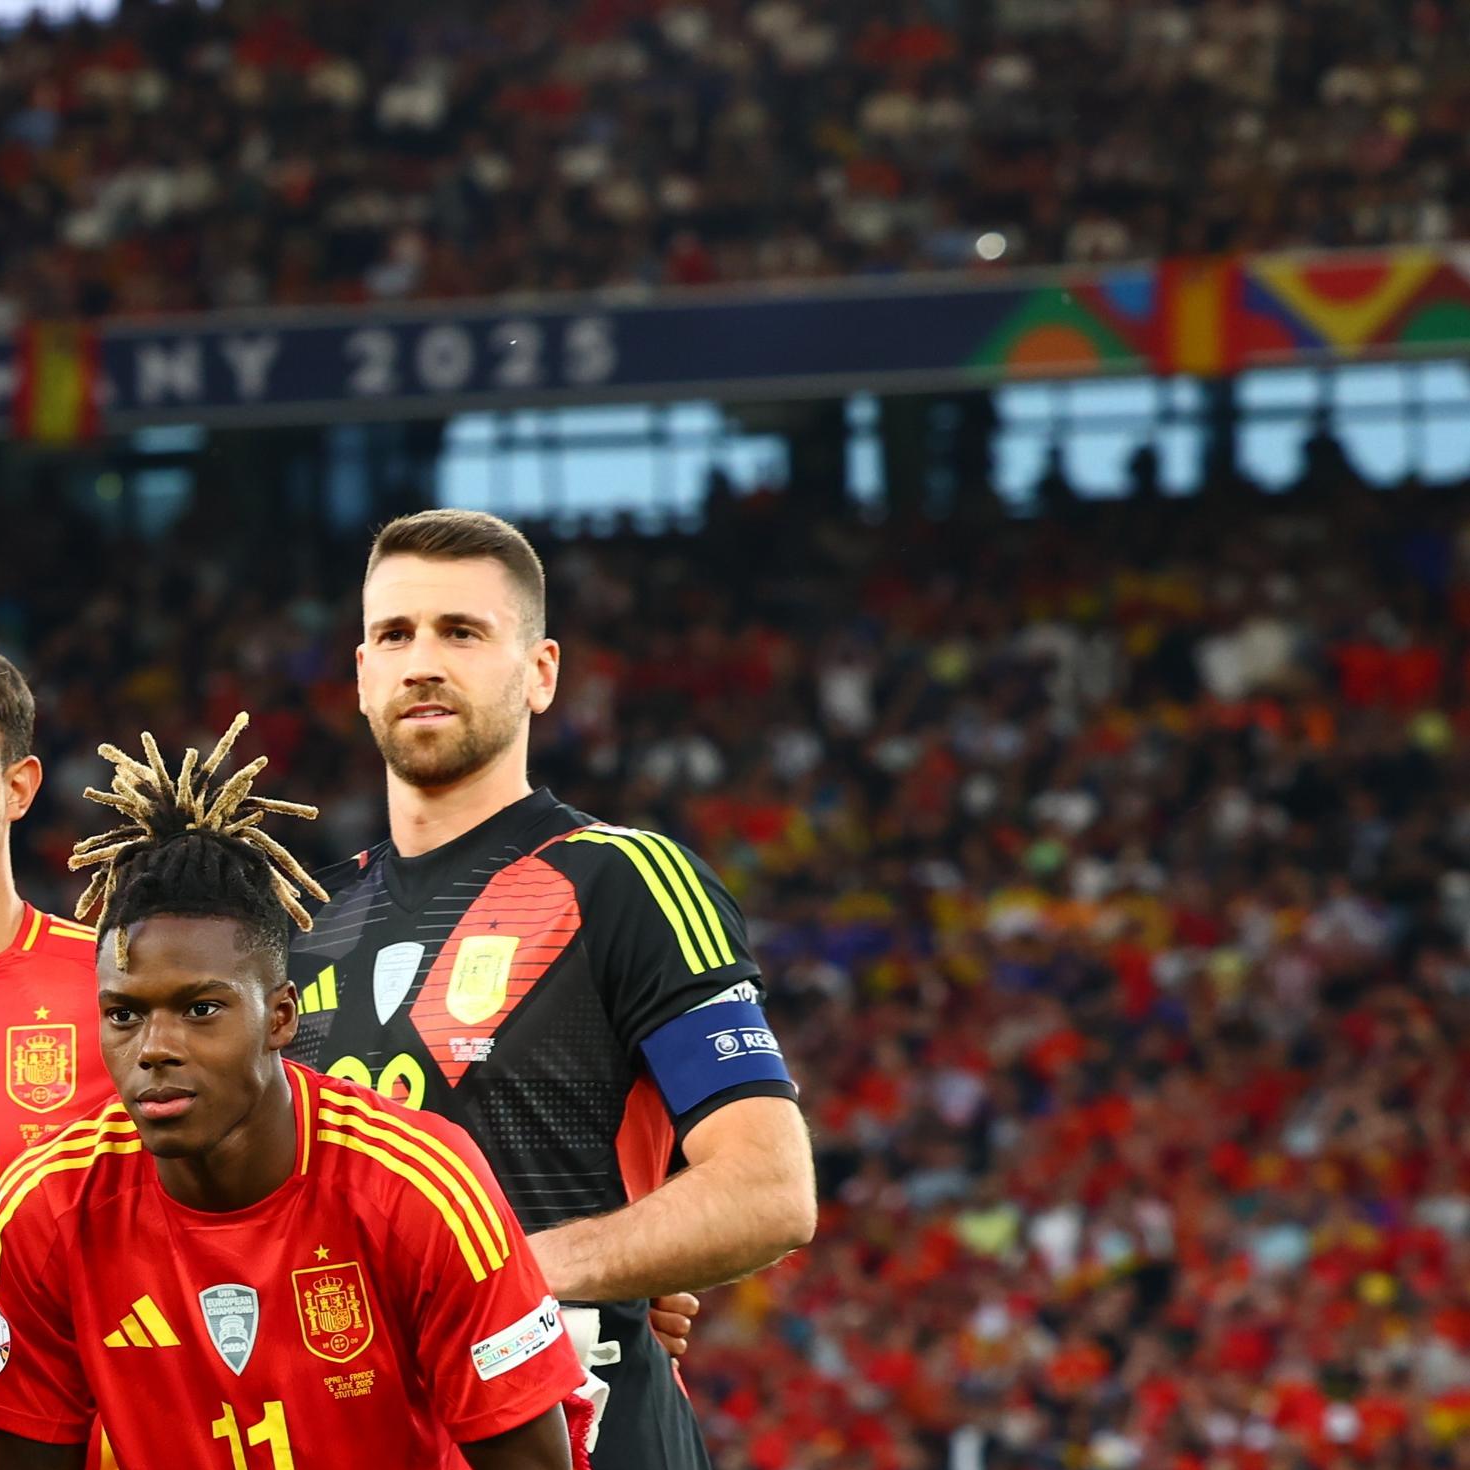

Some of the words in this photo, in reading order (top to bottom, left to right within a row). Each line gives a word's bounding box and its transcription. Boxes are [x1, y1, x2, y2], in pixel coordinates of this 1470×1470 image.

[345, 318, 615, 397] 2025
[205, 1295, 252, 1308] EUROPEAN
[207, 1305, 254, 1316] CHAMPIONS
[221, 1342, 247, 1354] 2024
[476, 1326, 541, 1367] FOUNDATION
[323, 1375, 343, 1386] SPAIN
[349, 1369, 376, 1381] FRANCE
[355, 1377, 374, 1389] 2025
[333, 1386, 372, 1400] STUTTGART
